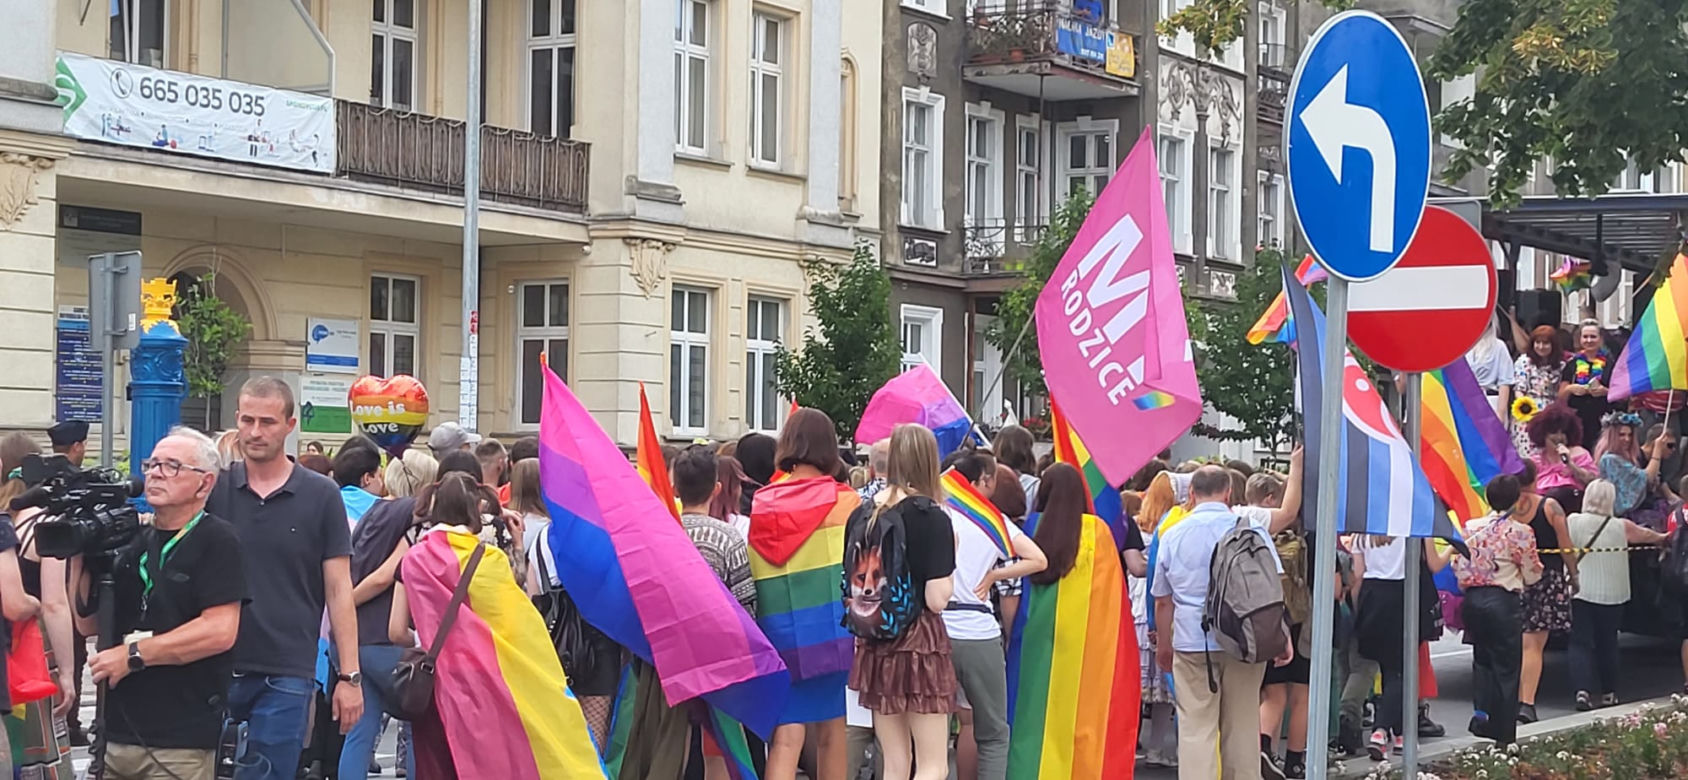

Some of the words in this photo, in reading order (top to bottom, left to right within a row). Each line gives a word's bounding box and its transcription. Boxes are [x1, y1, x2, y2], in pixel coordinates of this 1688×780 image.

[140, 76, 179, 103] 665
[185, 84, 222, 110] 035
[228, 91, 265, 117] 035
[1060, 269, 1135, 406] RODZICE
[387, 400, 406, 415] is
[360, 421, 399, 434] Love
